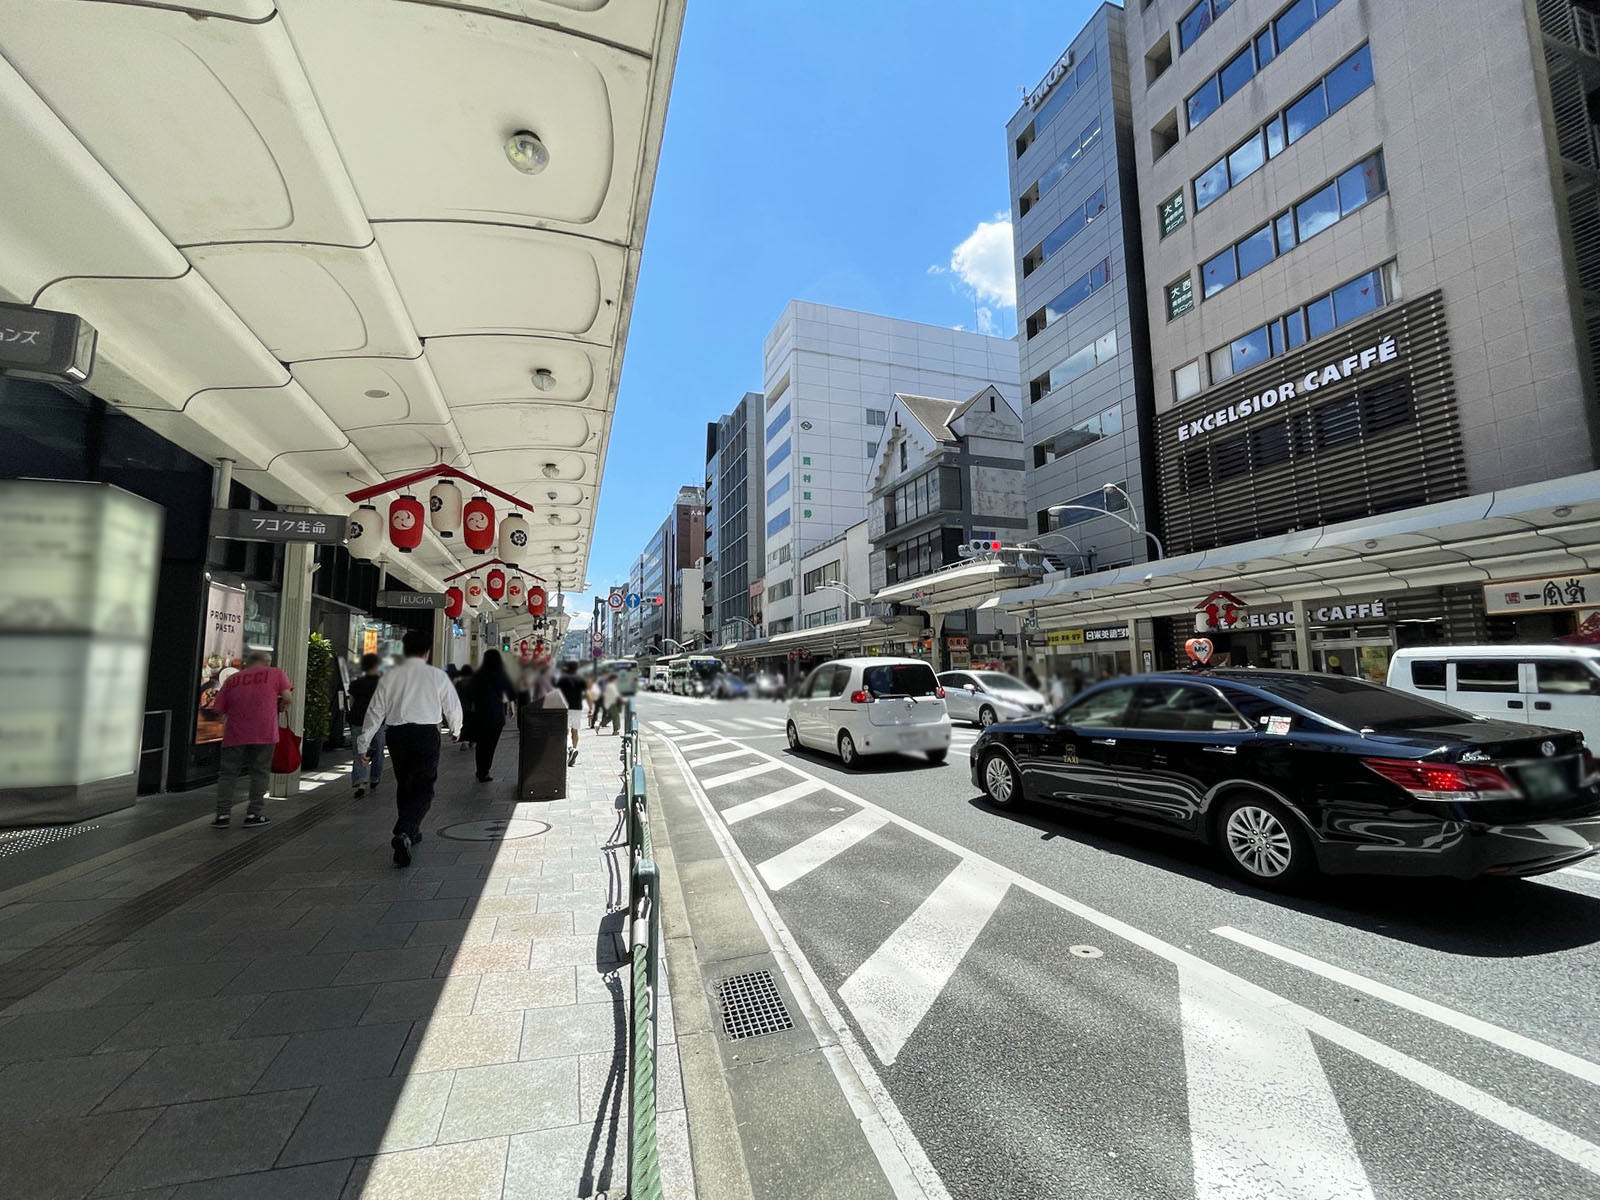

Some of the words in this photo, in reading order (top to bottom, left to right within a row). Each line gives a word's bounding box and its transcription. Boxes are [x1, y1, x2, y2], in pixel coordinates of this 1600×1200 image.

[1177, 382, 1296, 442] EXCELSIOR
[1303, 336, 1398, 392] CAFFÉ
[252, 518, 326, 534] フコク生命
[1524, 578, 1586, 606] 一風堂
[209, 609, 241, 624] PRONTO'S
[1219, 610, 1311, 630] EELSIO
[1317, 599, 1385, 622] CAFFÉ
[215, 622, 236, 633] PASTA
[1194, 645, 1208, 653] MK
[1063, 755, 1079, 764] TAXI
